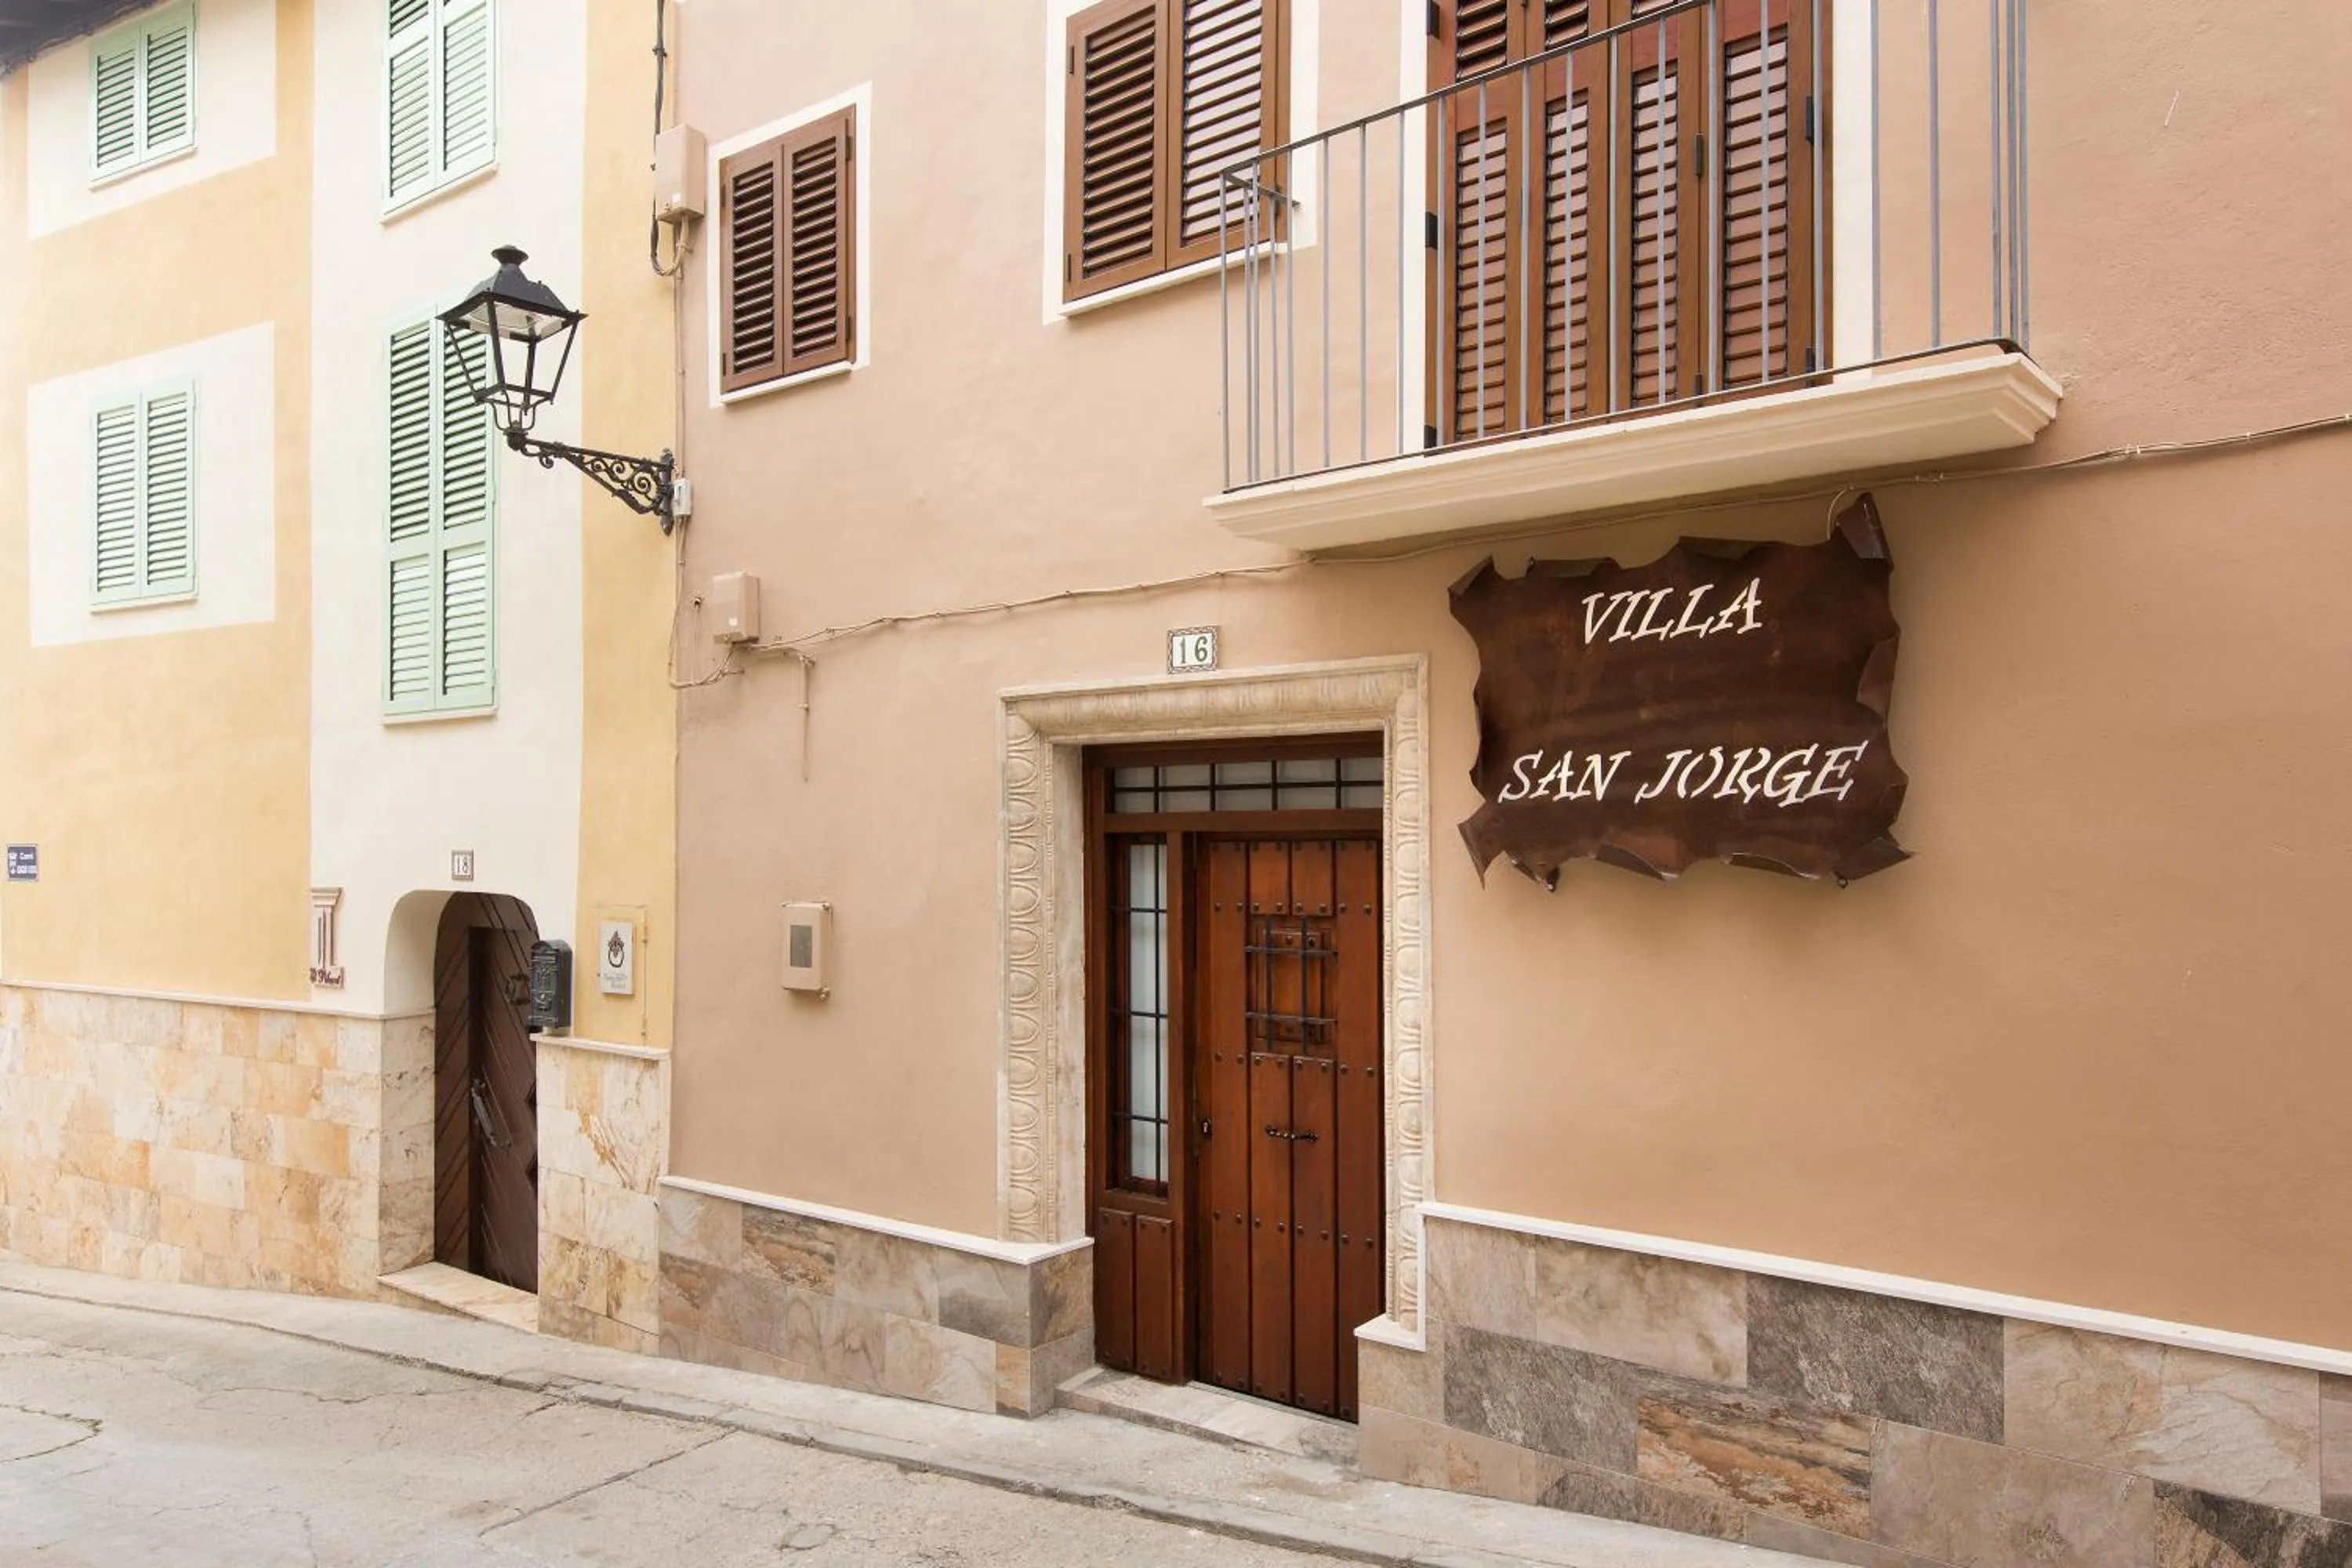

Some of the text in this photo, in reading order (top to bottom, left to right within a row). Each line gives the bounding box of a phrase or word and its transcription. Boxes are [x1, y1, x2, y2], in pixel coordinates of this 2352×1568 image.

[1581, 578, 1762, 644] VILLA
[1180, 635, 1208, 664] 16
[1497, 739, 1869, 808] SAN JORGE
[457, 855, 470, 874] 18
